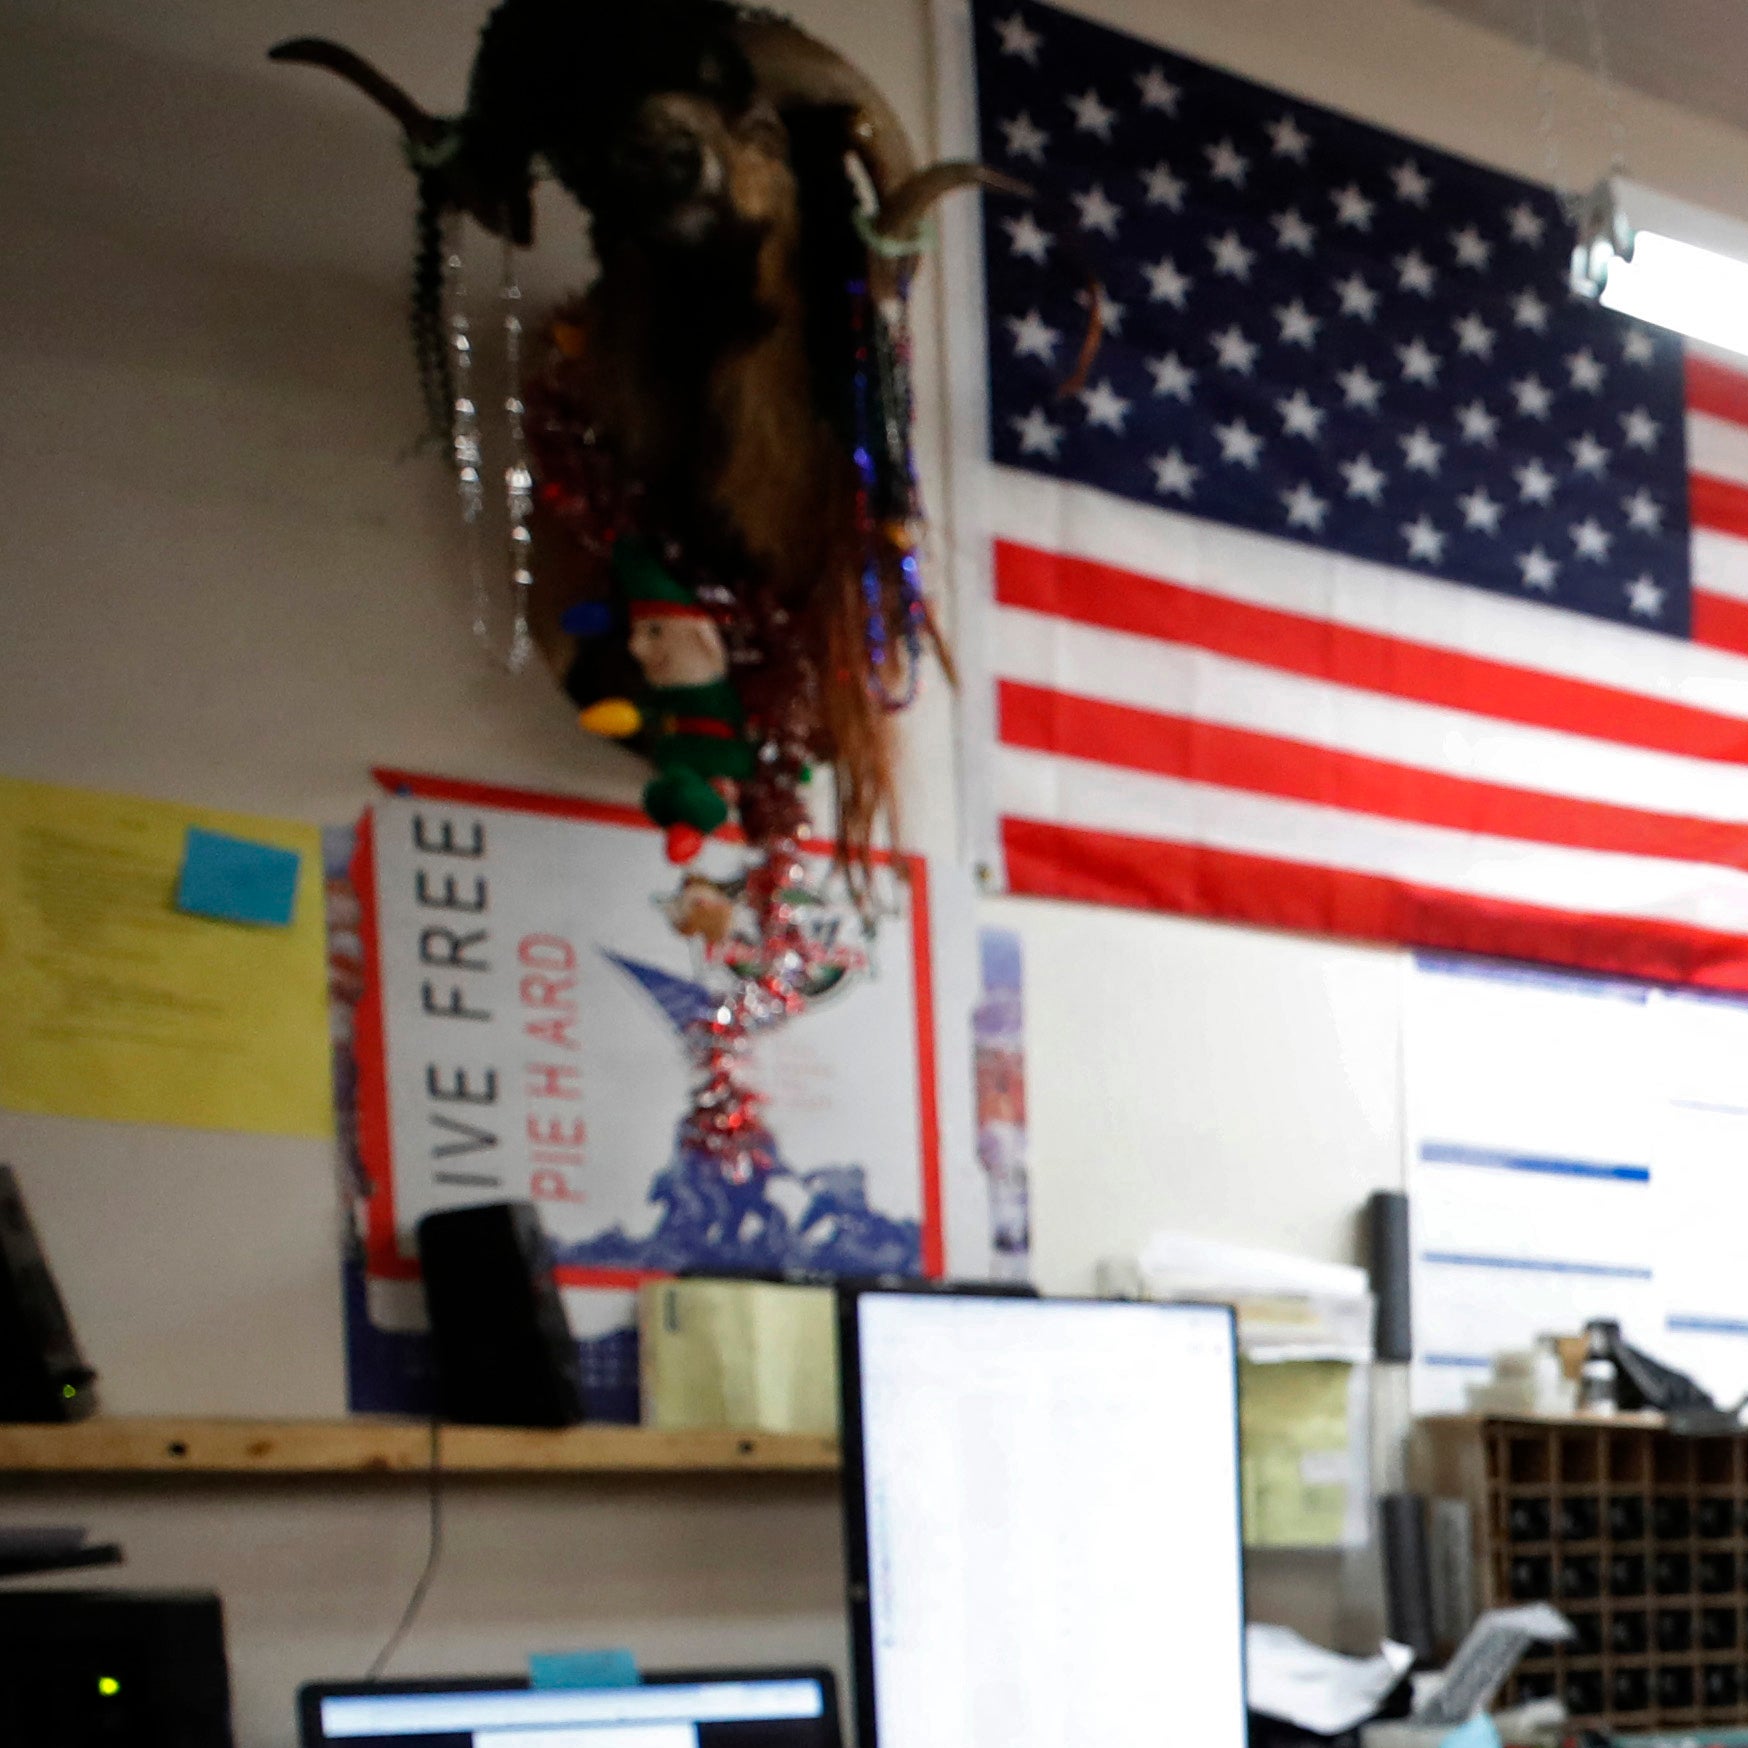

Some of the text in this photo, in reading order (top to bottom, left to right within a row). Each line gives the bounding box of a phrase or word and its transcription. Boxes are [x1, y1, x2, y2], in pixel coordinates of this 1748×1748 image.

[411, 812, 503, 1188] IVE FREE
[516, 932, 587, 1205] PIE HARD
